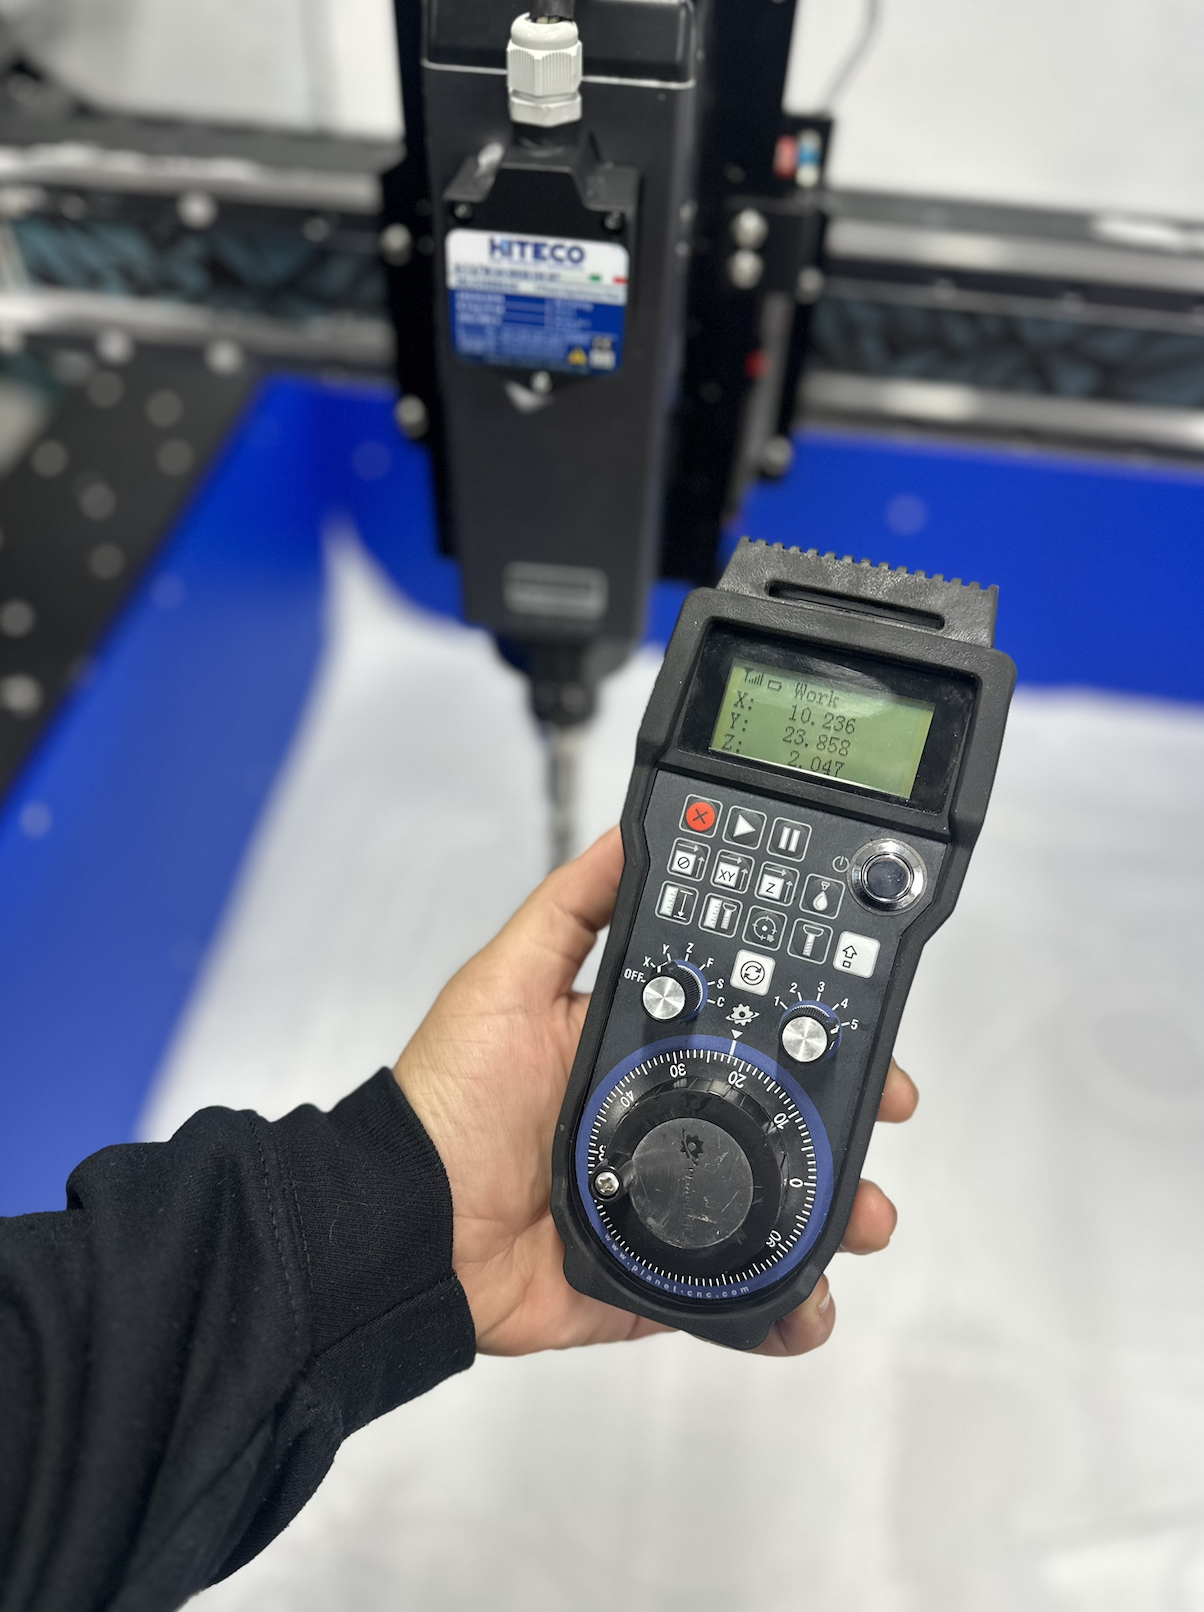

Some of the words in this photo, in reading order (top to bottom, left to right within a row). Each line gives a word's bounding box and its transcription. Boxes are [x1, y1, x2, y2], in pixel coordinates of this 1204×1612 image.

[489, 237, 585, 264] HITECO
[795, 681, 840, 709] Work
[733, 690, 754, 711] X:
[788, 704, 857, 734] 10.236
[729, 711, 749, 732] Y:
[782, 726, 852, 757] 23.858
[721, 733, 743, 754] Z:
[787, 750, 845, 778] 2.047
[718, 869, 736, 882] XY
[765, 882, 776, 894] Z
[662, 943, 670, 955] Y
[685, 942, 695, 954] Z
[642, 955, 651, 968] X
[706, 957, 715, 968] F
[623, 968, 645, 983] OFF
[716, 978, 725, 989] S
[789, 982, 798, 994] 2
[817, 981, 826, 992] 3
[716, 996, 725, 1008] C
[774, 995, 780, 1006] 1
[840, 997, 849, 1009] 4
[850, 1018, 859, 1030] 5
[669, 1062, 687, 1079] 30
[728, 1070, 747, 1089] 20
[620, 1089, 635, 1108] 40
[773, 1112, 790, 1131] 10
[789, 1177, 804, 1188] 0
